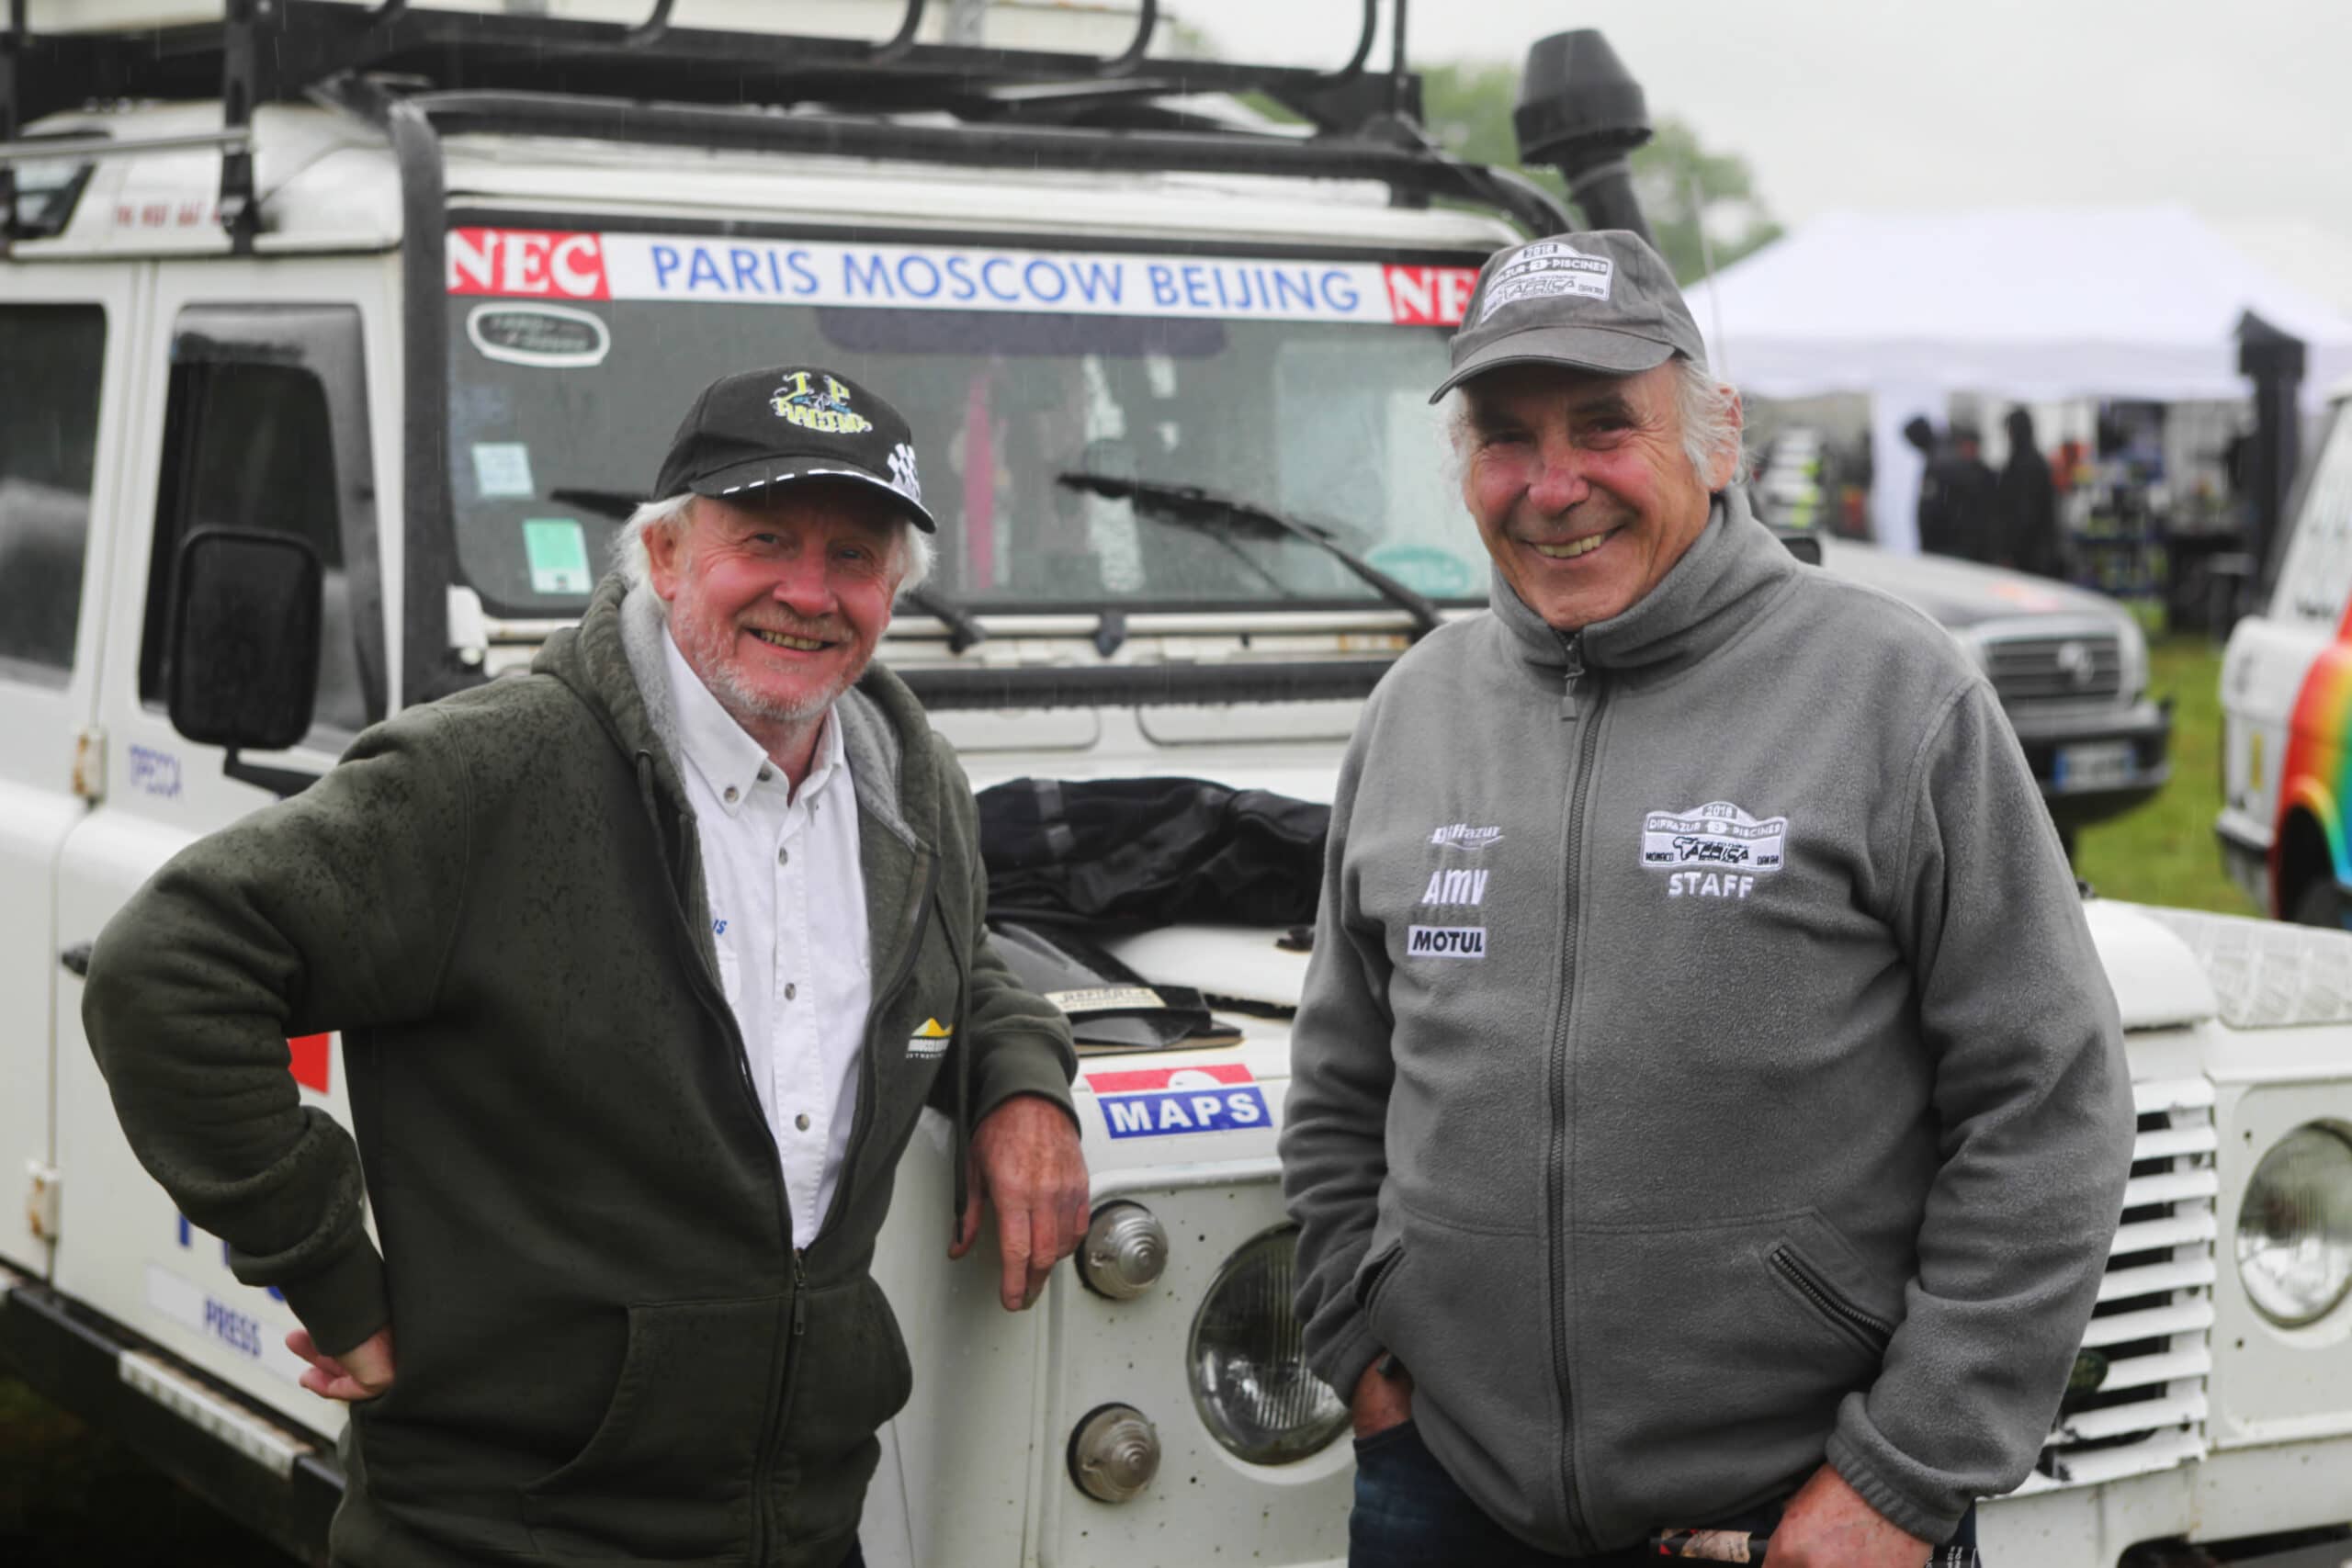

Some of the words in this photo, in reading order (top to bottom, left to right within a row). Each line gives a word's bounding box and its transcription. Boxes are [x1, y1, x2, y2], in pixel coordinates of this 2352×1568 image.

[446, 232, 601, 296] NEC
[651, 245, 819, 295] PARIS
[842, 254, 1123, 305] MOSCOW
[1148, 265, 1360, 312] BEIJING
[1388, 268, 1476, 320] NE
[1553, 257, 1607, 273] PISCINES
[1668, 871, 1755, 898] STAFF
[1412, 930, 1484, 953] MOTUL
[1108, 1092, 1261, 1134] MAPS
[205, 1296, 261, 1357] PRESS
